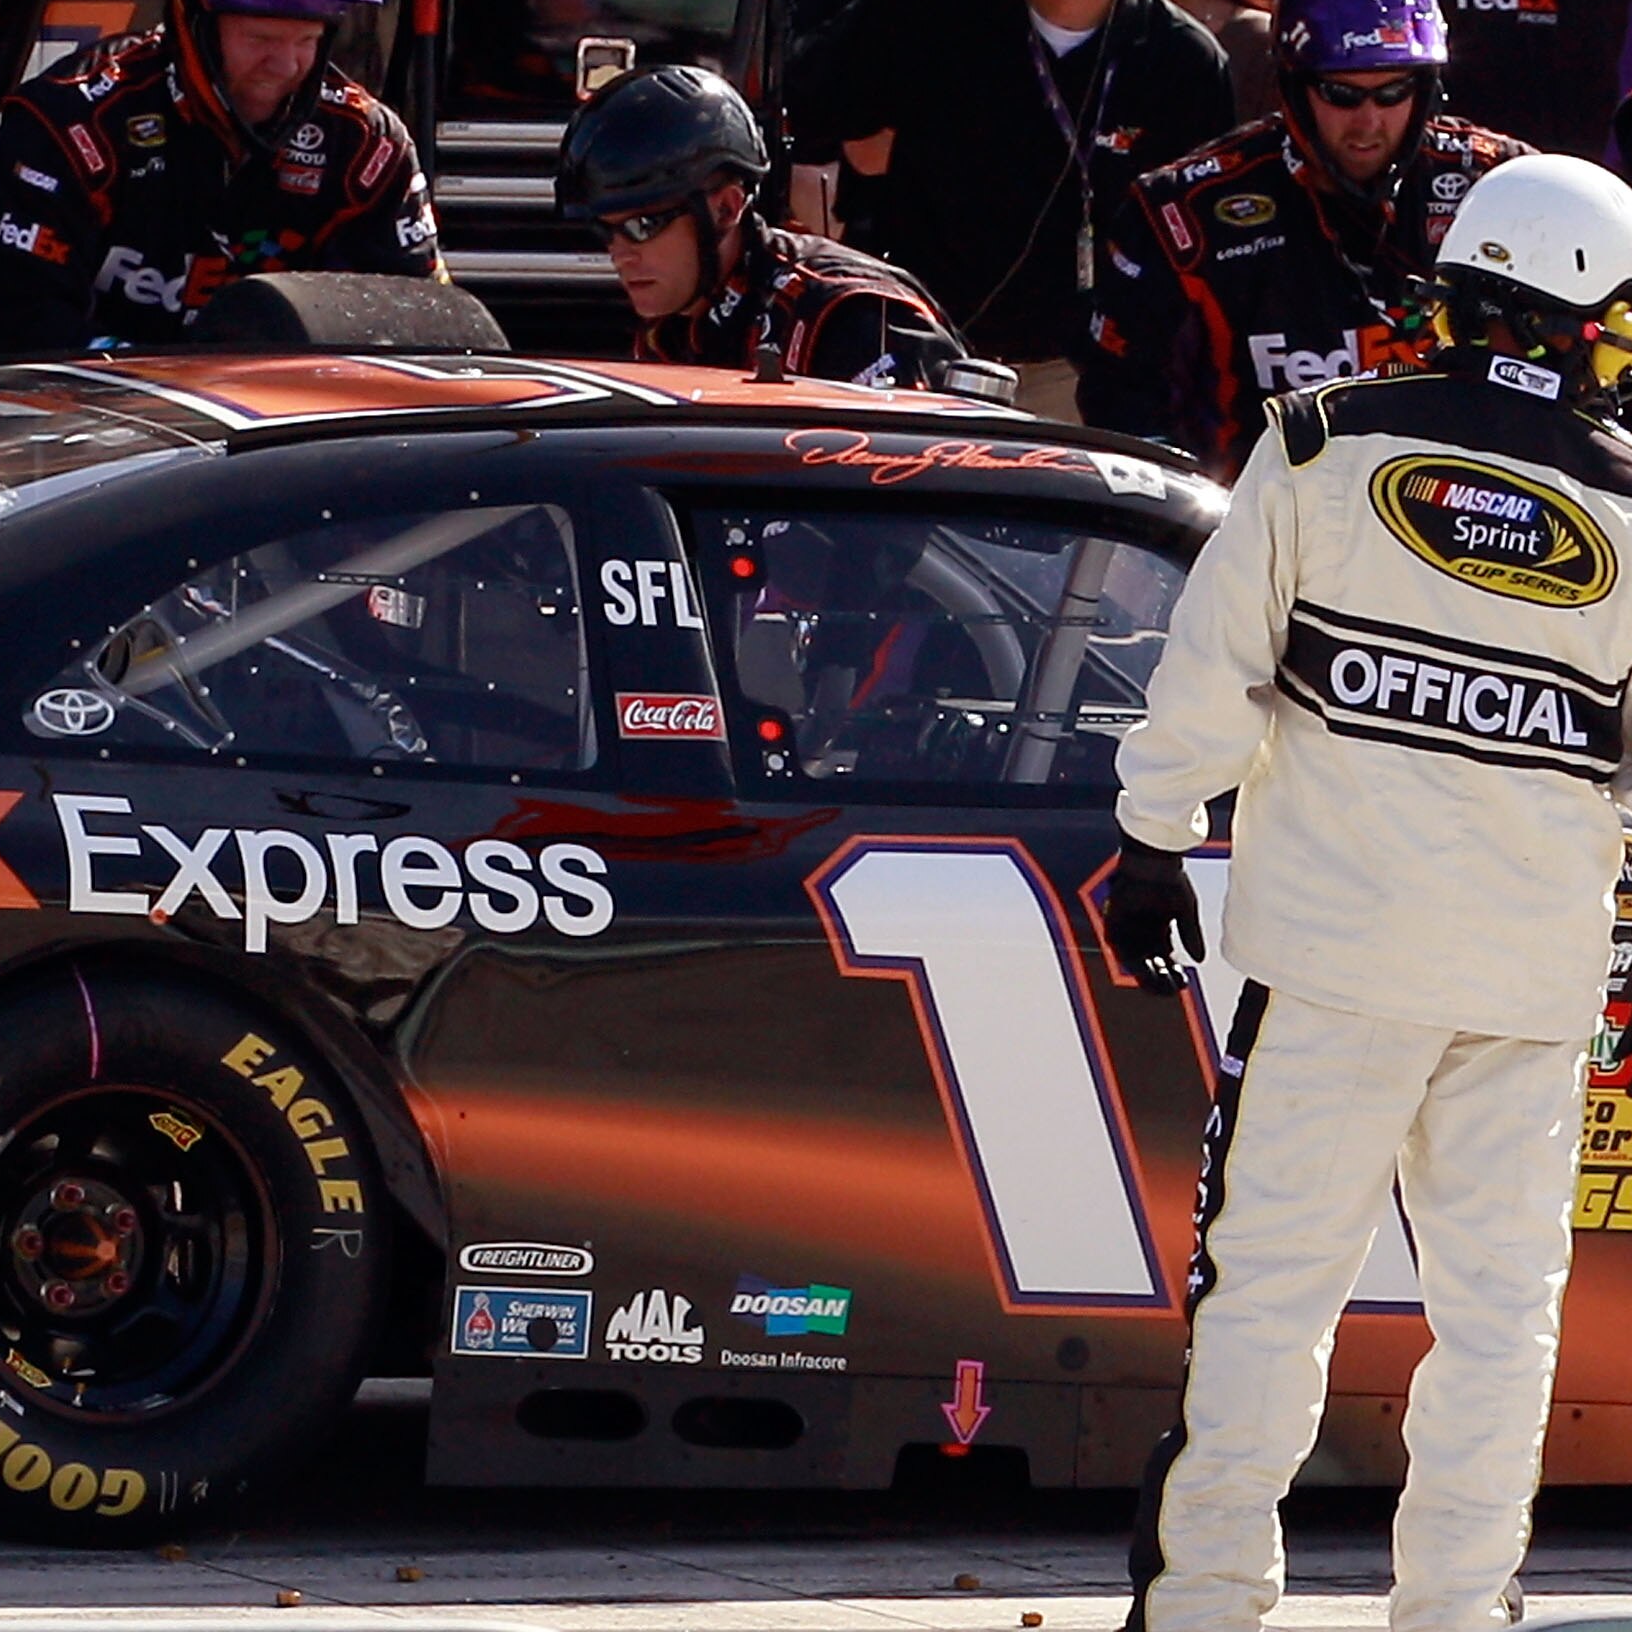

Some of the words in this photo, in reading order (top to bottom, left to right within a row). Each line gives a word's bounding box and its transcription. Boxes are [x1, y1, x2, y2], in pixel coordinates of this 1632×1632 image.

[1216, 235, 1286, 261] GOODYEAR
[95, 246, 230, 313] FedE
[1441, 481, 1535, 522] NASCAR
[1453, 515, 1543, 557] Sprint
[600, 559, 705, 630] SFL
[1457, 563, 1506, 584] CUP
[1509, 569, 1582, 601] SERIES
[1329, 649, 1589, 747] OFFICIAL
[51, 793, 614, 953] Express
[221, 1032, 364, 1215] EAGLE
[471, 1245, 581, 1269] FREIGHTLINER
[505, 1301, 576, 1320] SHERWIN
[606, 1289, 705, 1344] MAC
[730, 1293, 848, 1318] DOOSAN
[500, 1317, 577, 1337] WILMS
[605, 1343, 704, 1363] TOOLS
[720, 1350, 778, 1368] Doosan
[780, 1351, 847, 1371] Infracore
